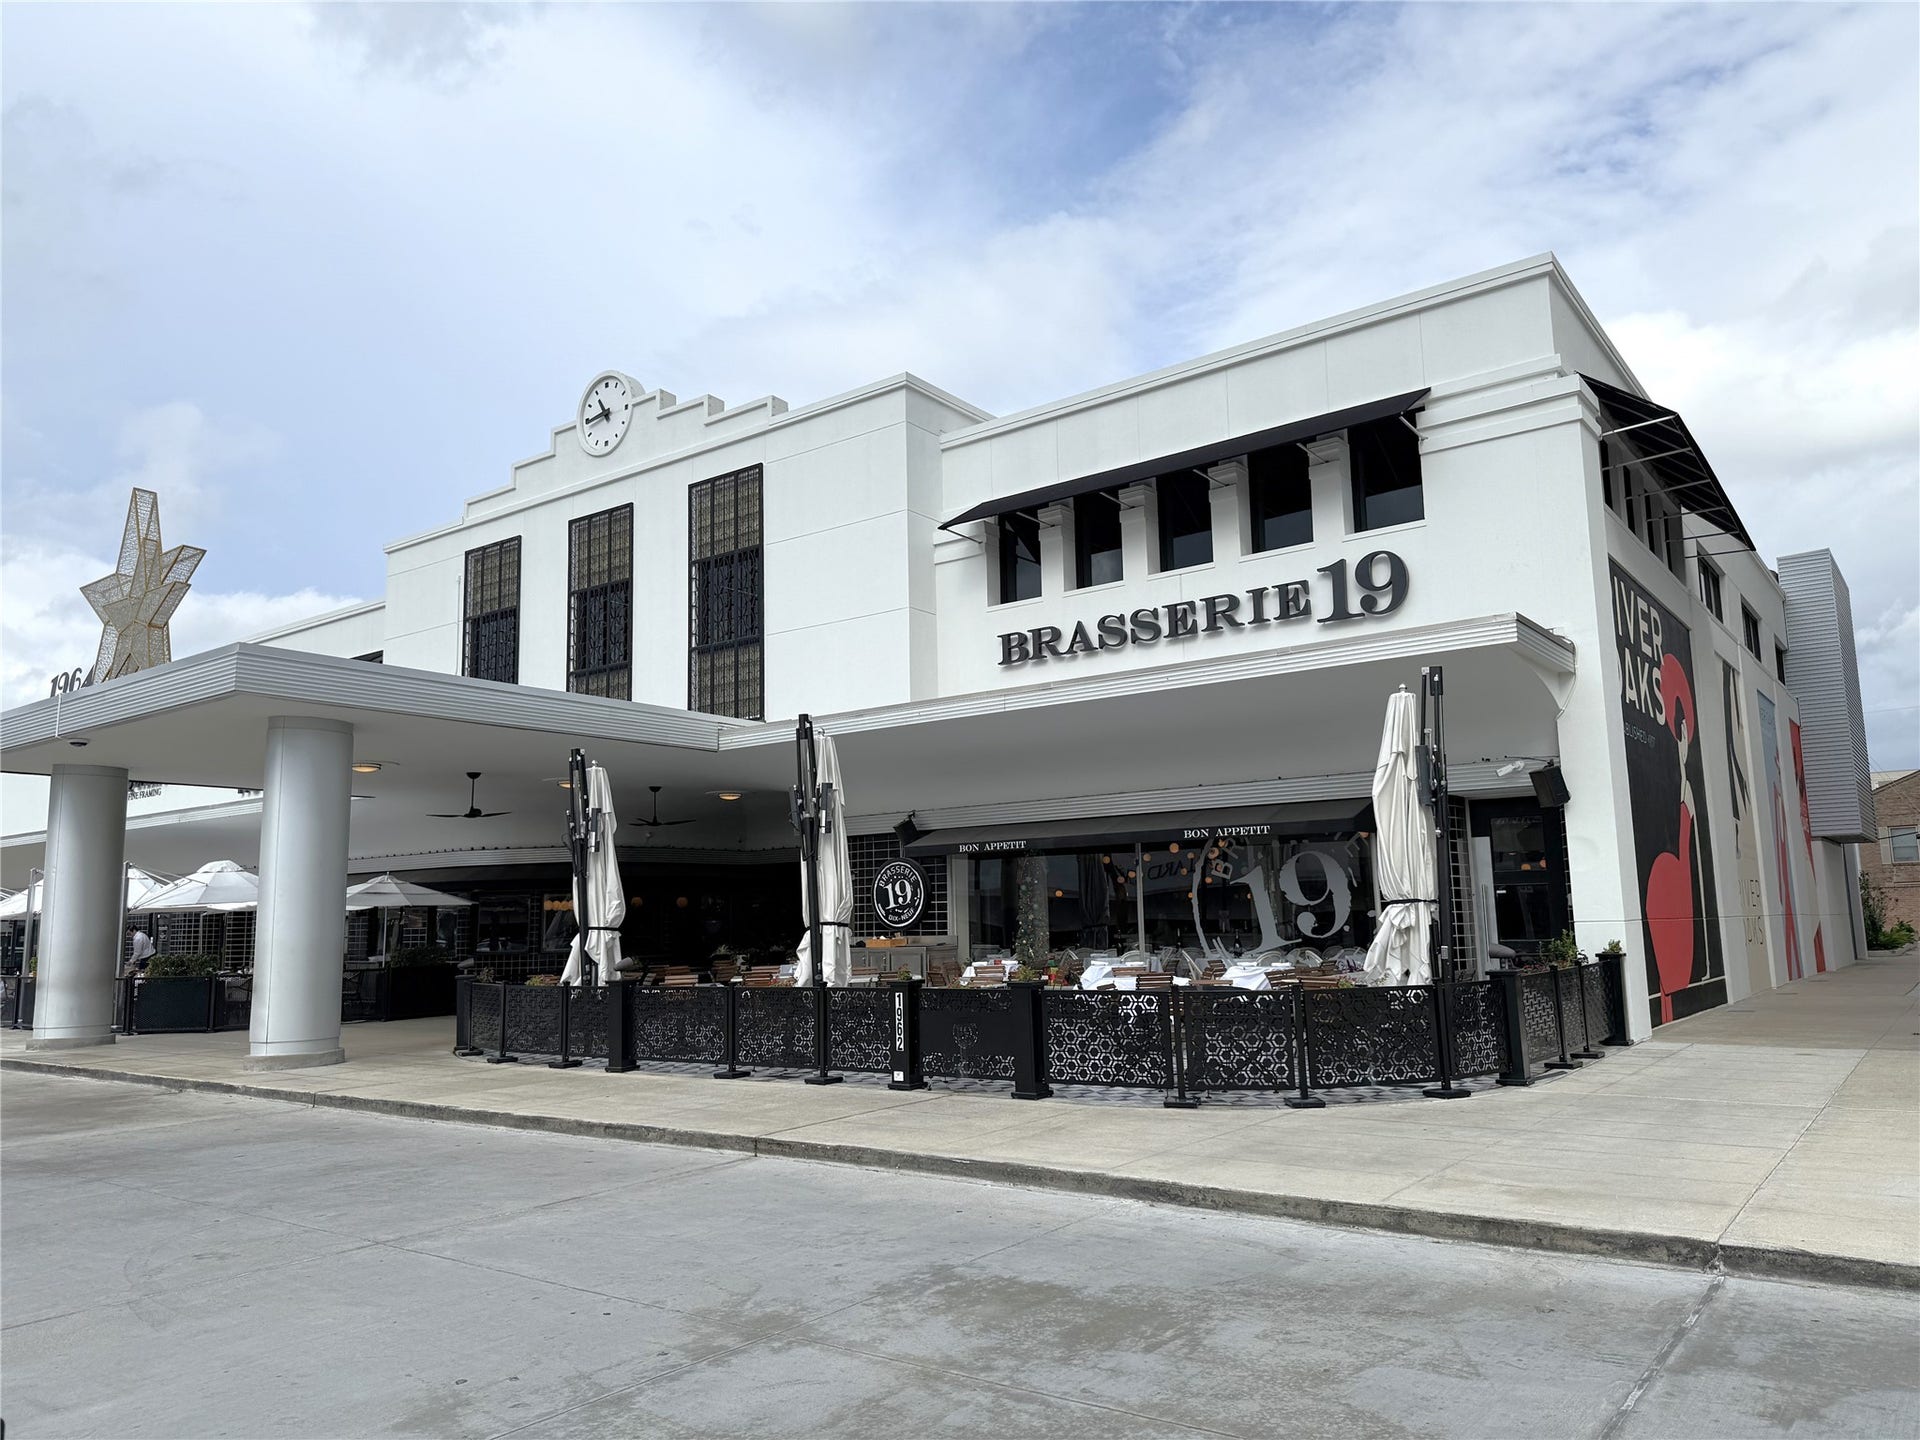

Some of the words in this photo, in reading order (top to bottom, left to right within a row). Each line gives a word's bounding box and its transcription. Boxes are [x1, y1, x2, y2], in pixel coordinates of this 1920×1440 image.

[997, 579, 1312, 666] BRASSERIE
[1316, 549, 1410, 624] 19
[1618, 647, 1666, 726] AKS
[959, 843, 980, 853] BON
[983, 840, 1027, 851] APPETIT
[1184, 828, 1209, 839] BON
[1215, 825, 1270, 837] APPETIT
[878, 865, 917, 887] BRASSERIE
[883, 879, 912, 910] 19
[1229, 850, 1352, 951] 19
